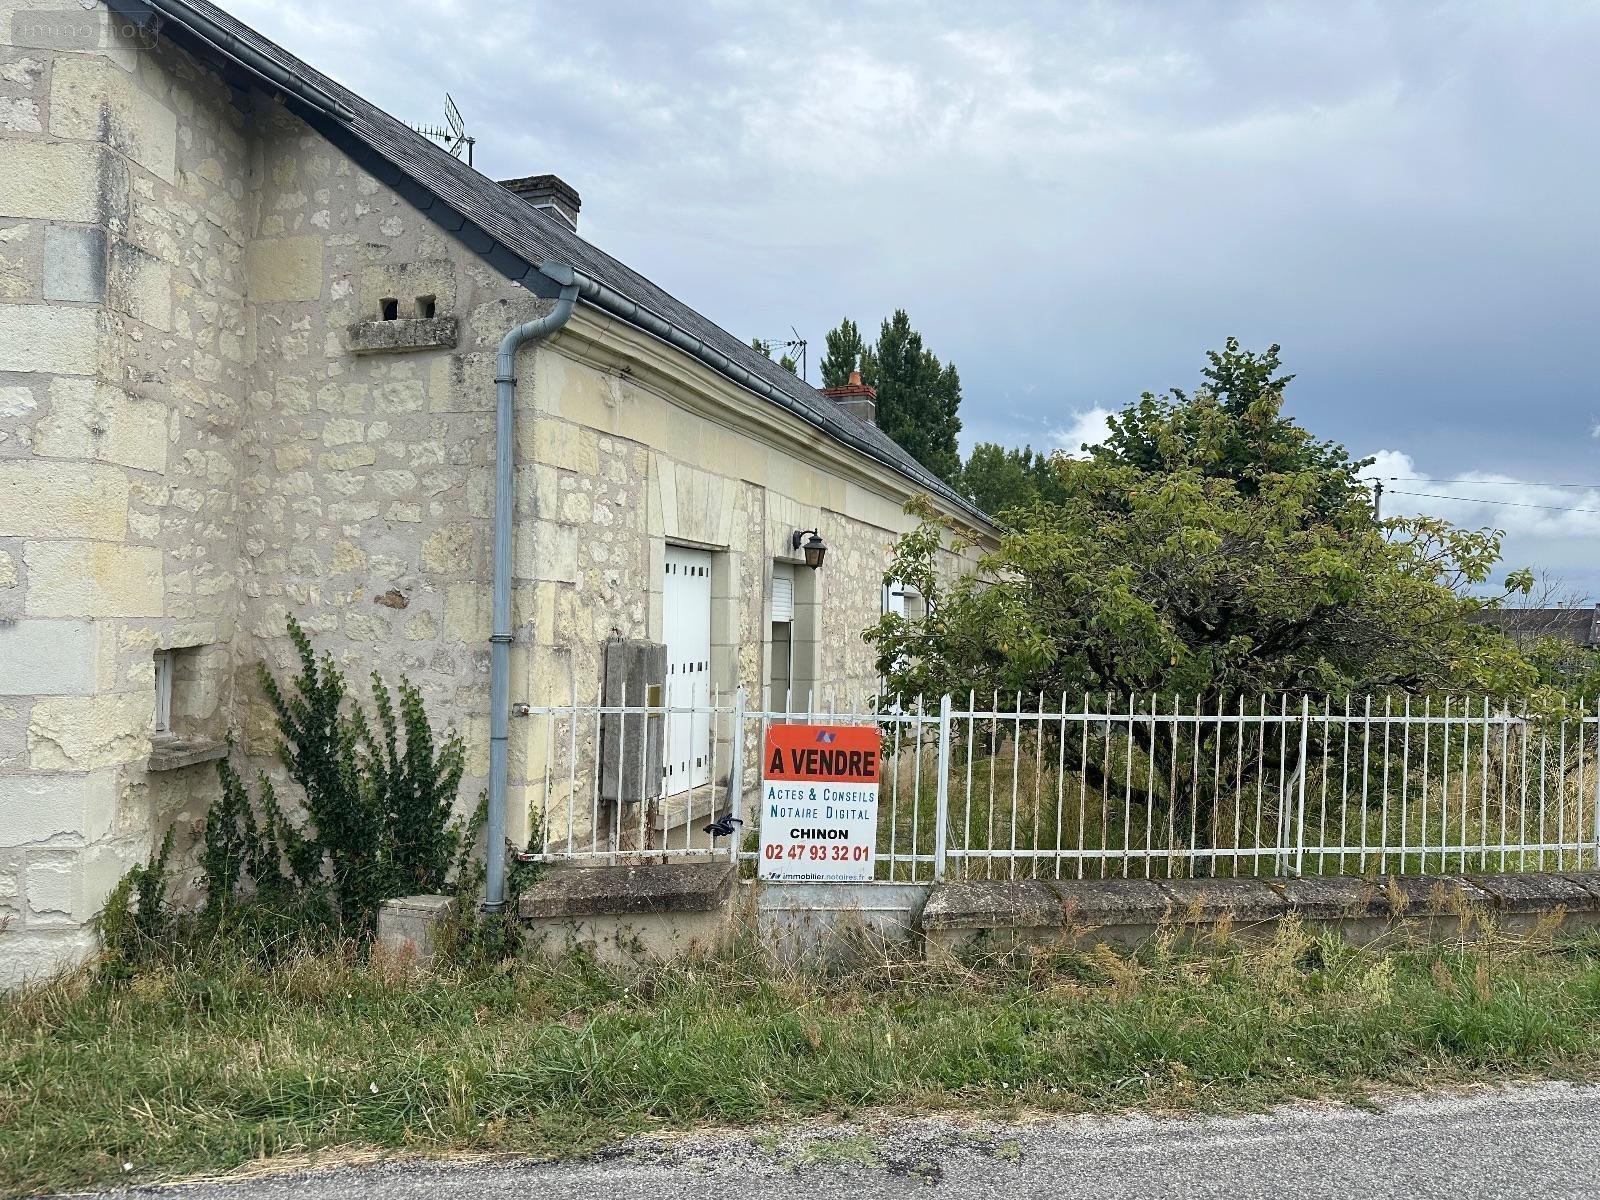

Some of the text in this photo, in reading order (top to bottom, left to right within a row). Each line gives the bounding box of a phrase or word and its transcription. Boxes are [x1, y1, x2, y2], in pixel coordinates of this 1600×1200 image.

[770, 748, 876, 777] A VENDRE
[808, 787, 817, 801] &
[790, 828, 849, 840] CHINON
[765, 844, 869, 862] 02 47 93 32 01
